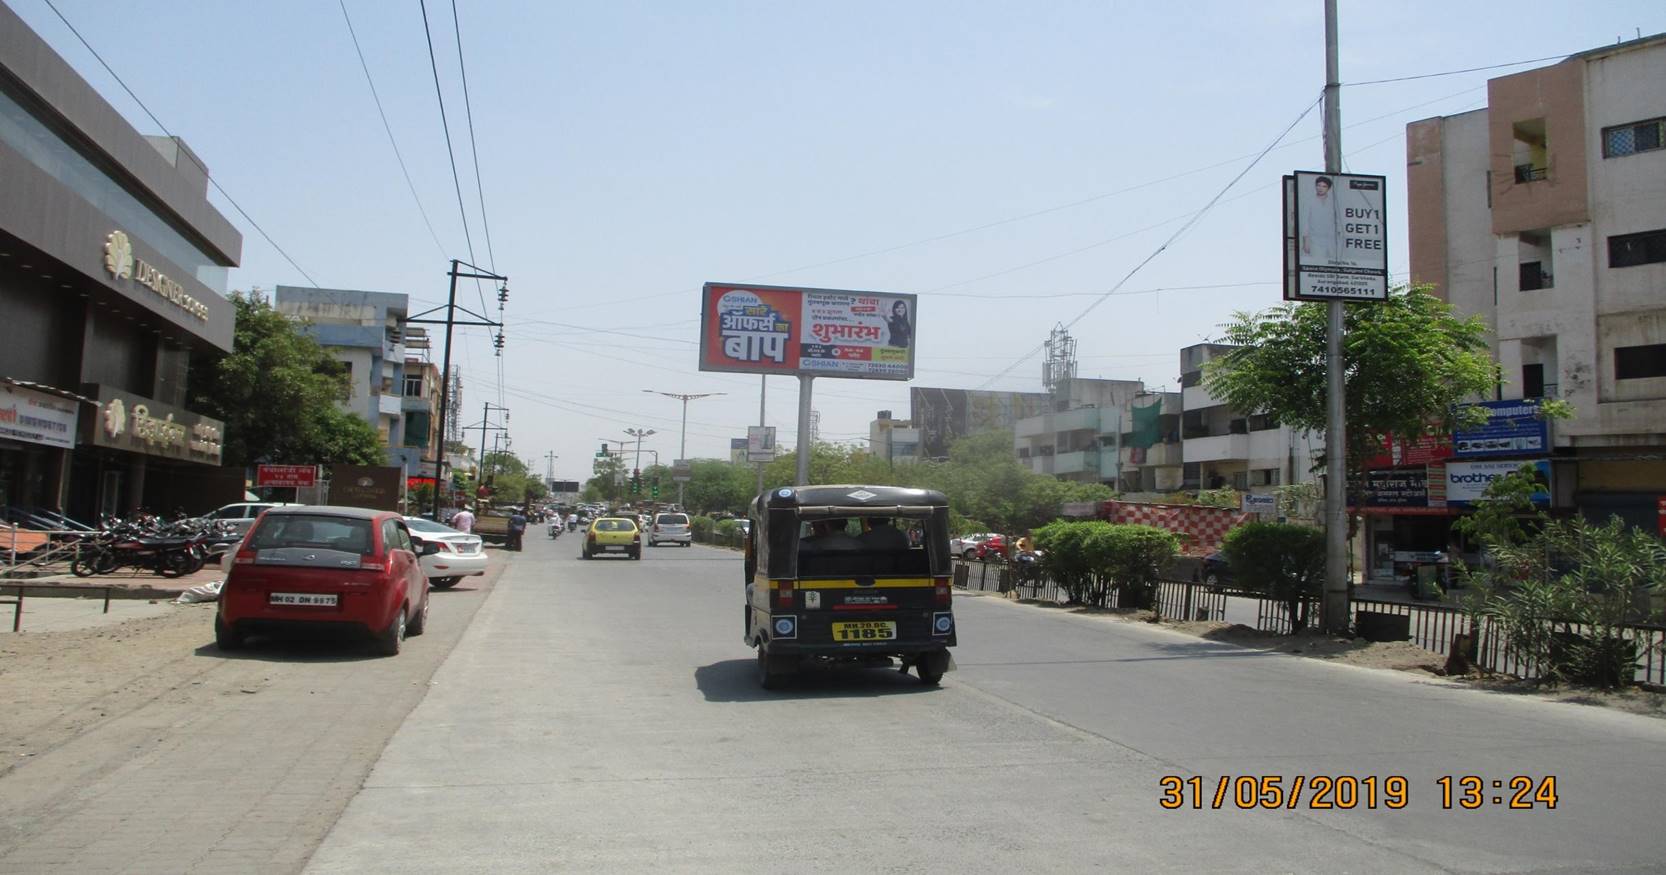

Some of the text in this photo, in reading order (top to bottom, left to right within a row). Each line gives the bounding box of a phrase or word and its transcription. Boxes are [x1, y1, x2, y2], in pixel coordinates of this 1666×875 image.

[1345, 238, 1382, 250] FREE
[1311, 285, 1375, 295] 7410565111
[722, 309, 776, 331] ऑफर्स
[812, 321, 881, 343] शुभारंभ
[722, 330, 789, 362] बाप
[837, 628, 893, 639] 1185
